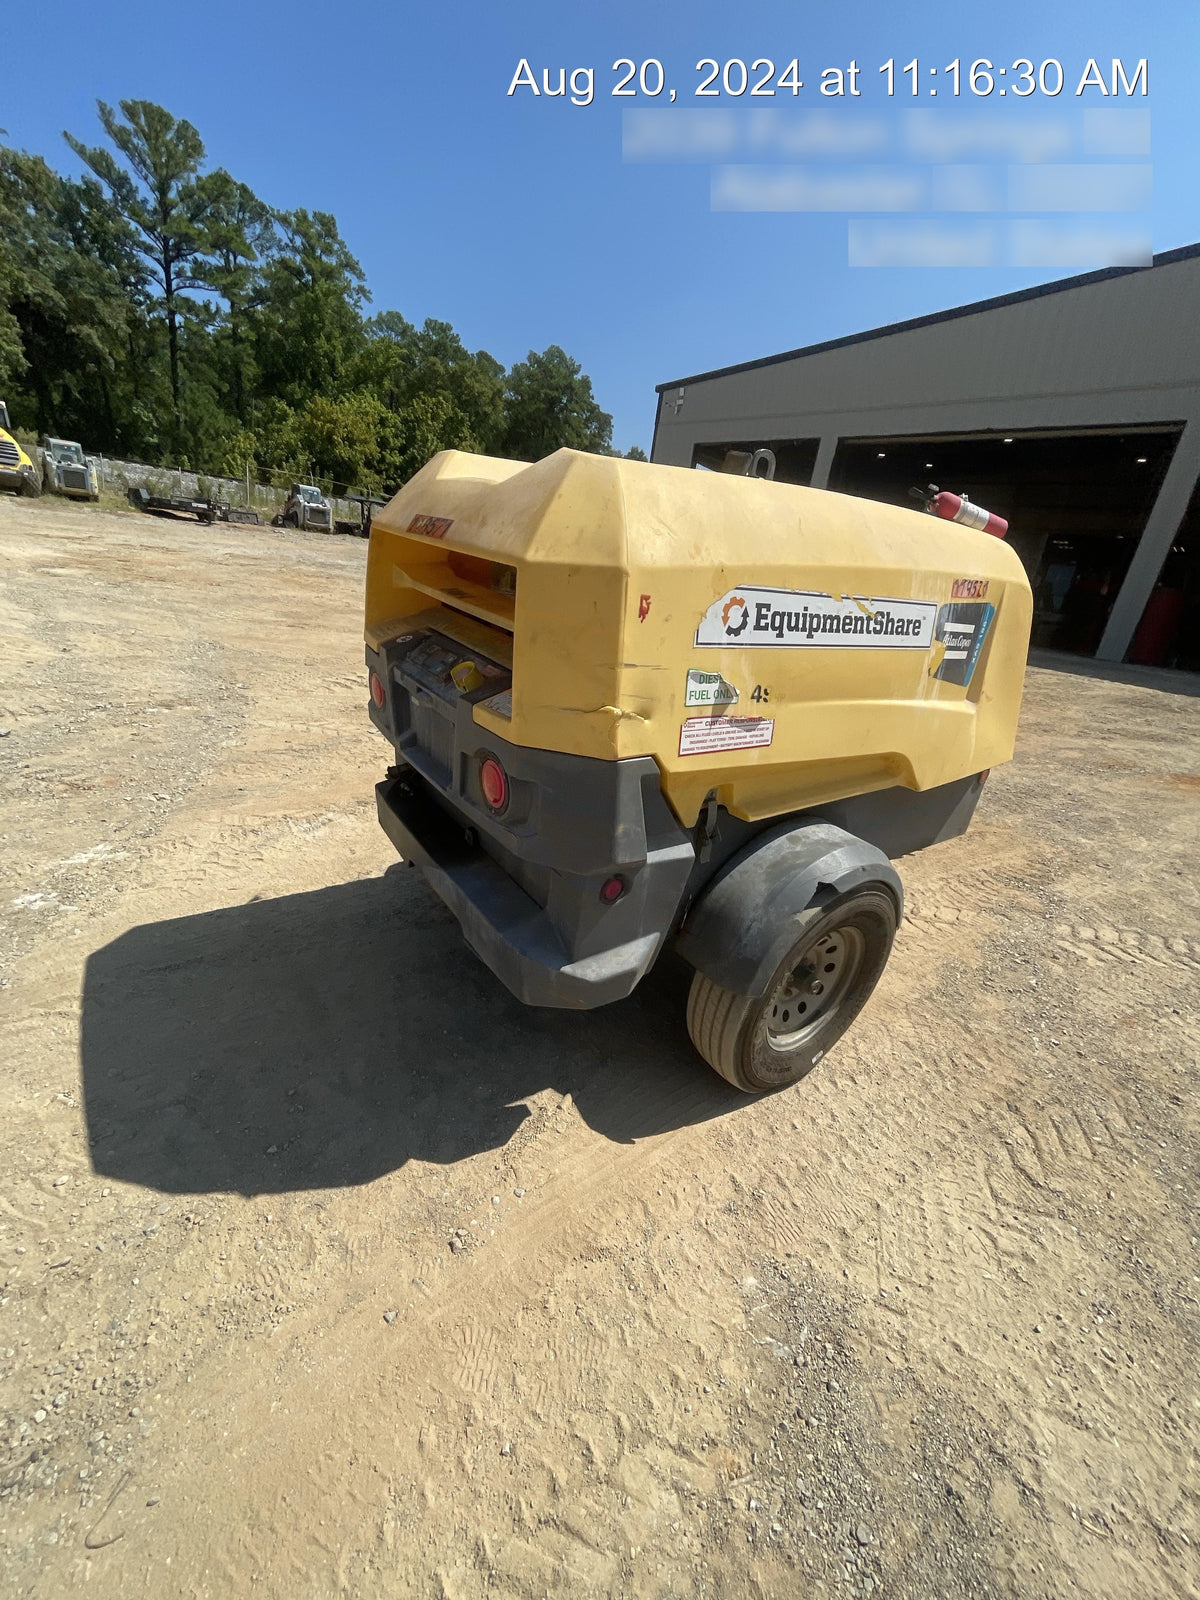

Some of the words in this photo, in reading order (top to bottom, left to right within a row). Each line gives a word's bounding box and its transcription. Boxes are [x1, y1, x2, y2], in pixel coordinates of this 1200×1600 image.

[753, 602, 922, 639] EquipmentShare
[698, 674, 725, 685] DIESE
[689, 689, 711, 701] FUEL
[713, 689, 733, 700] ONL
